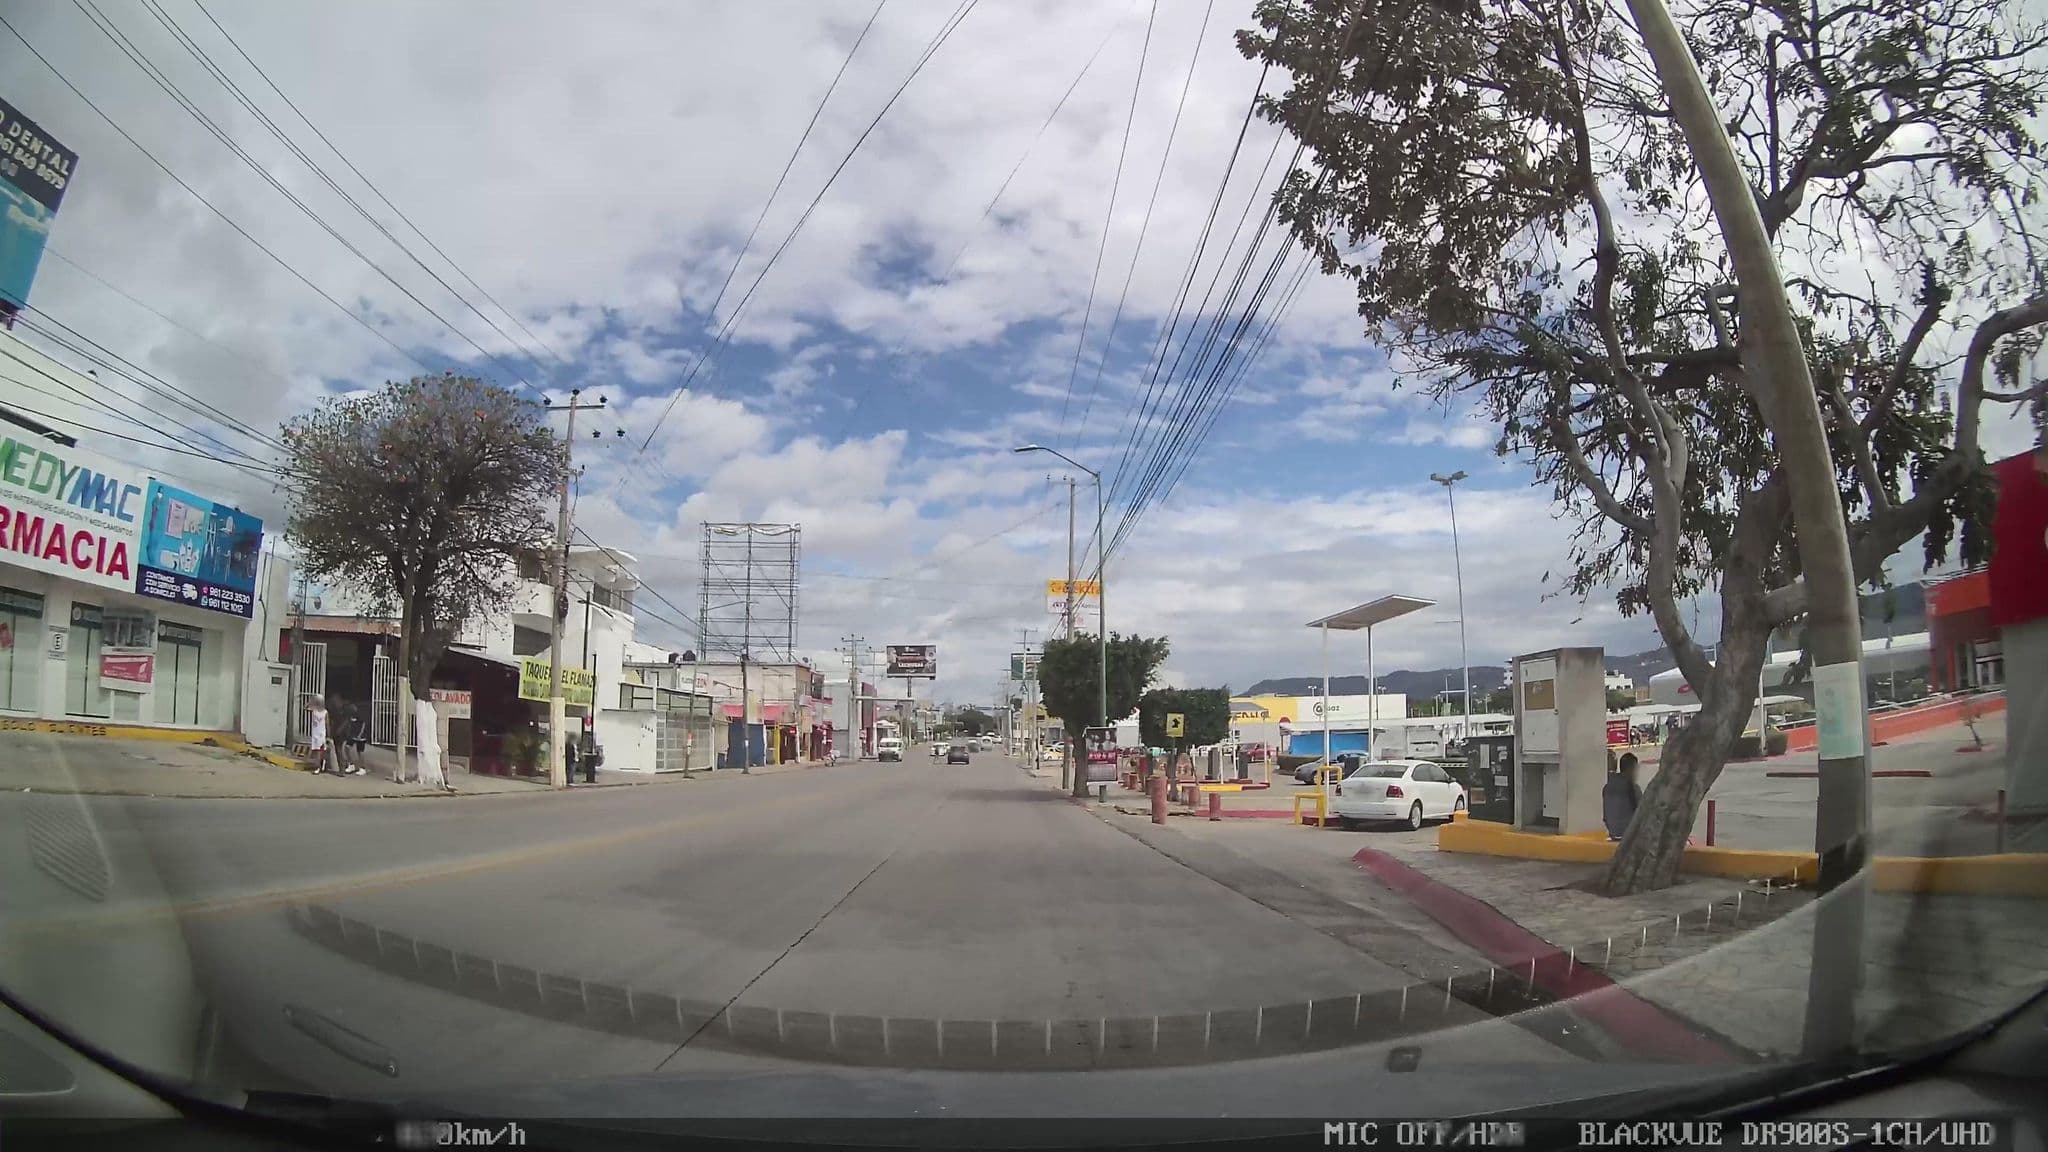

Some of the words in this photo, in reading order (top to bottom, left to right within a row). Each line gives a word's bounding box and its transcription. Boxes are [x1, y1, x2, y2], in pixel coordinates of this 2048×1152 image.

[9, 121, 70, 175] DENTAL
[209, 587, 221, 598] 961
[221, 589, 234, 600] 223
[234, 593, 251, 604] 3530
[208, 598, 220, 608] 961
[221, 601, 230, 611] 112
[561, 671, 569, 684] EL
